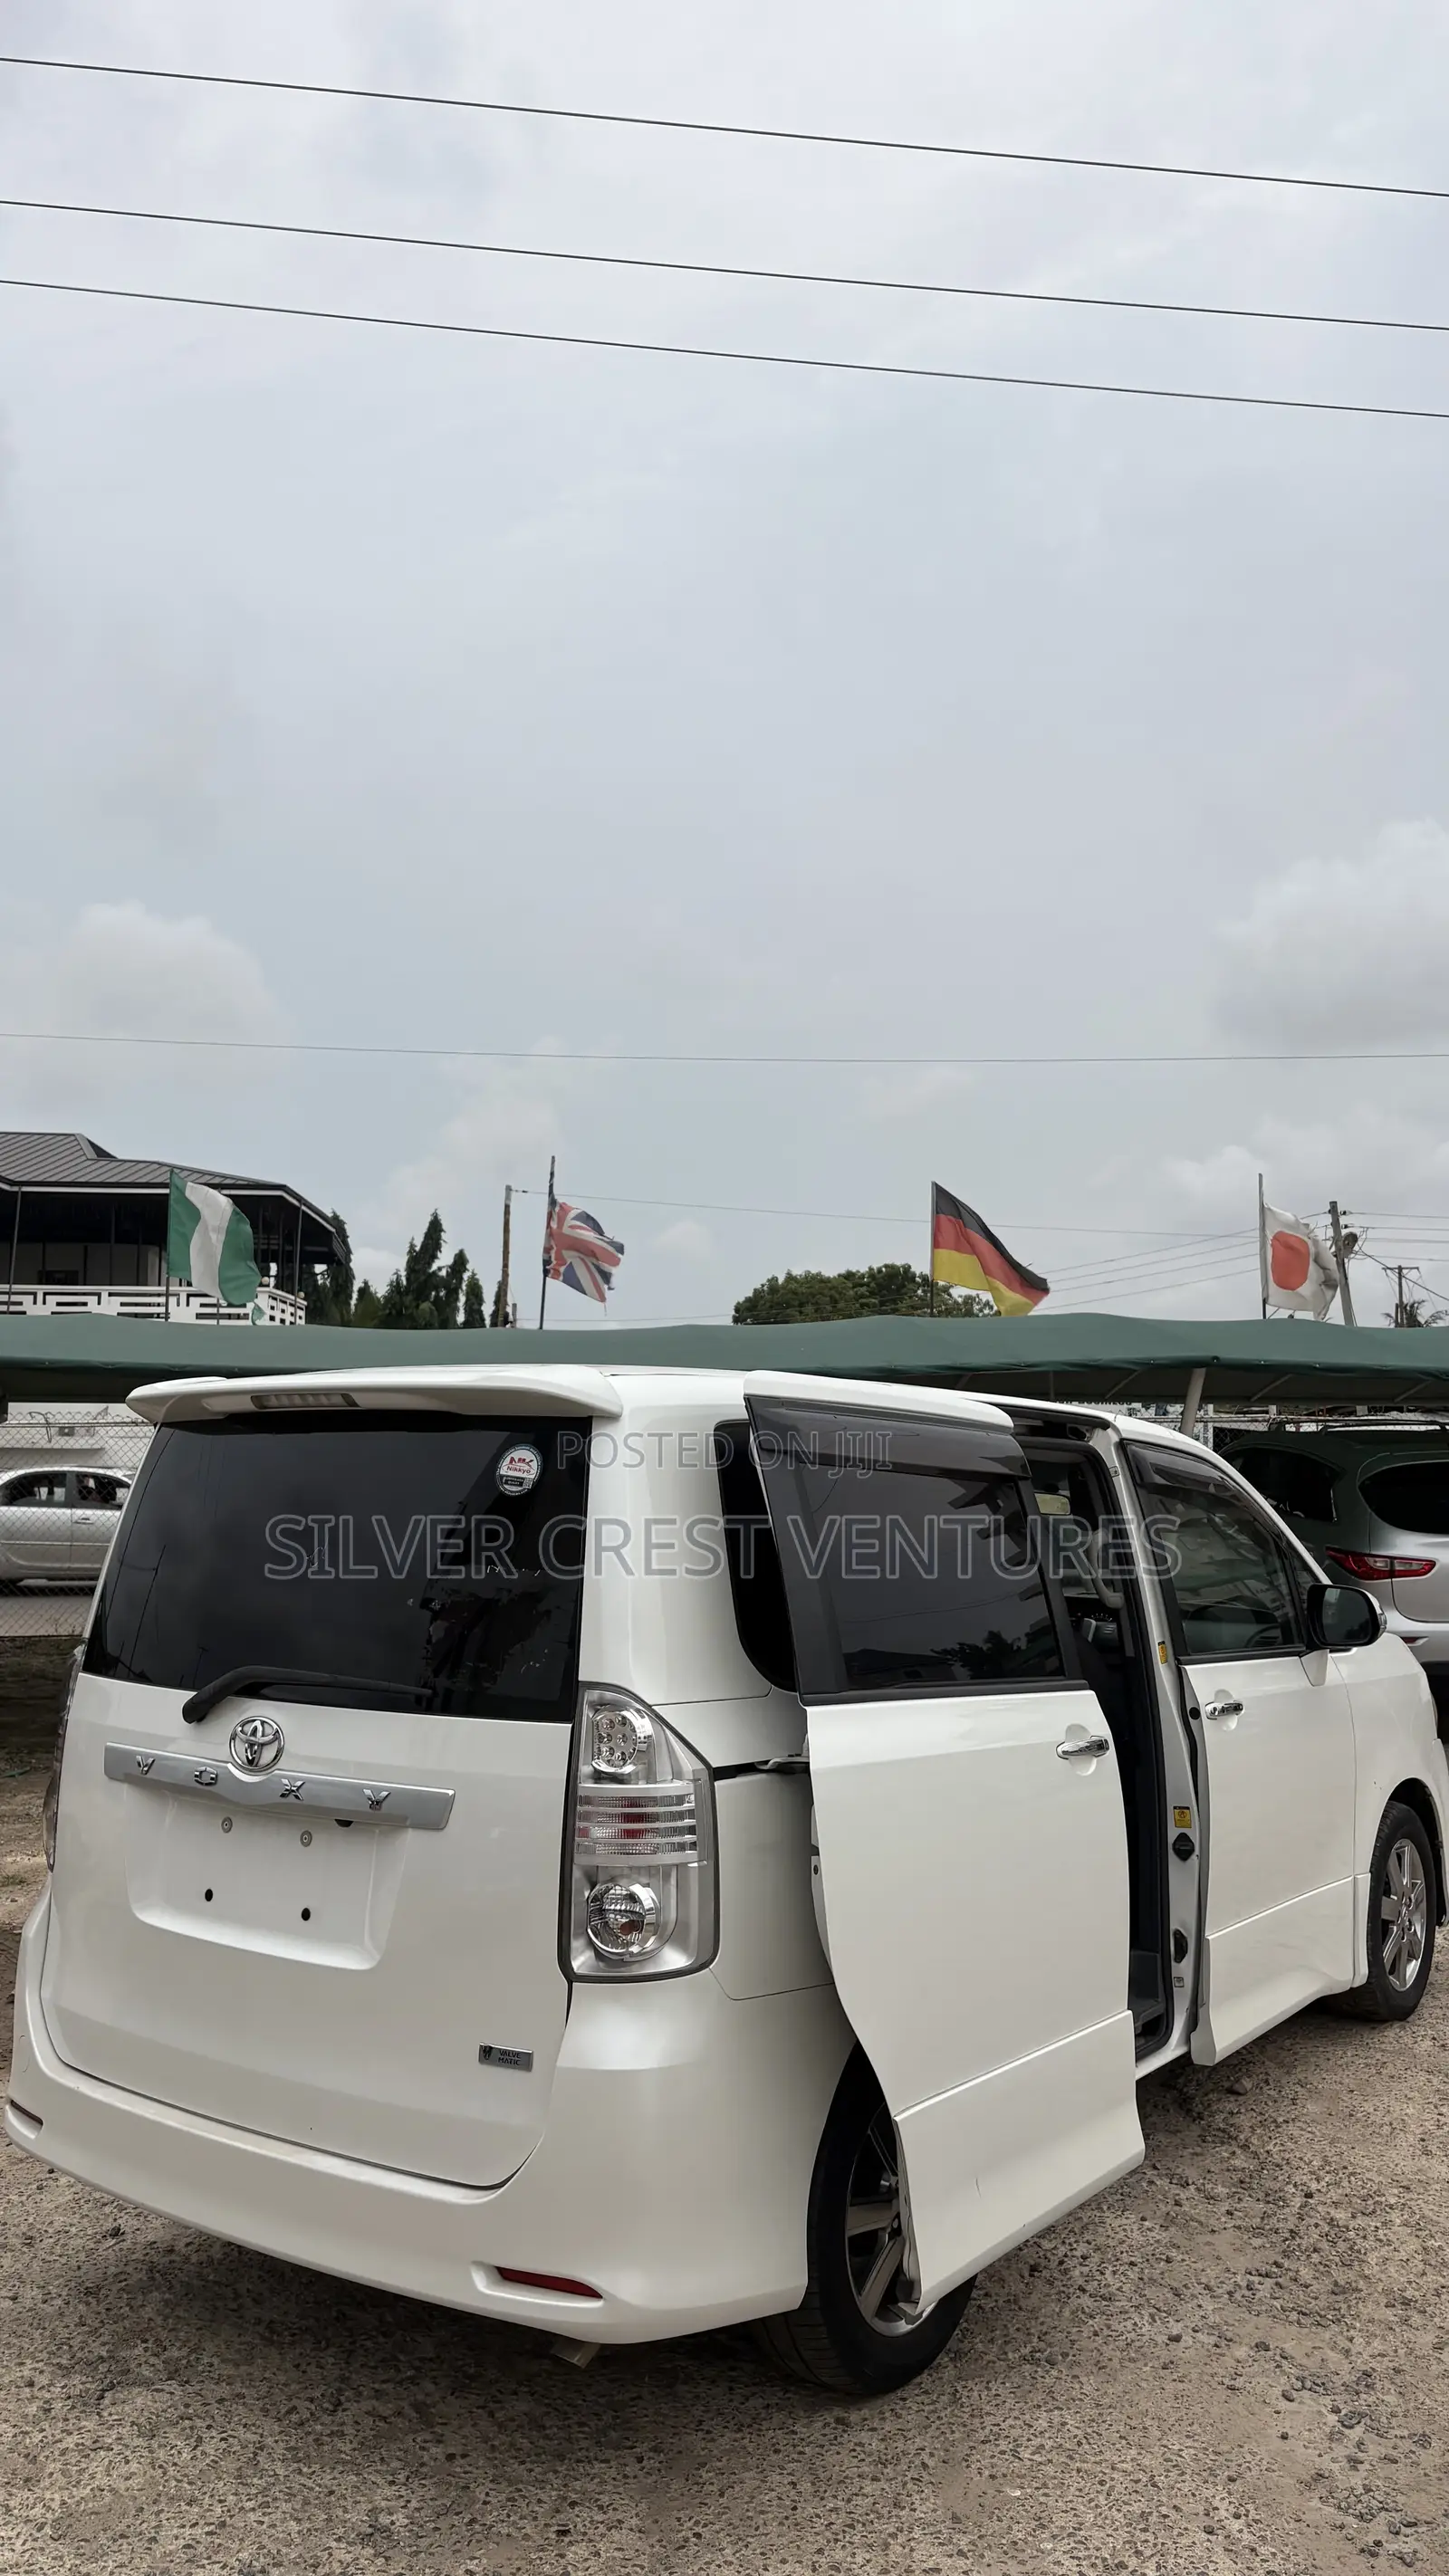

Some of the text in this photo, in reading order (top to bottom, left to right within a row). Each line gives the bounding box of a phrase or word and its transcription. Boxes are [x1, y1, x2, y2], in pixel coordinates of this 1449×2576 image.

[136, 1755, 391, 1811] VOXY
[499, 2049, 522, 2059] VALVE
[498, 2056, 522, 2065] MATIC
